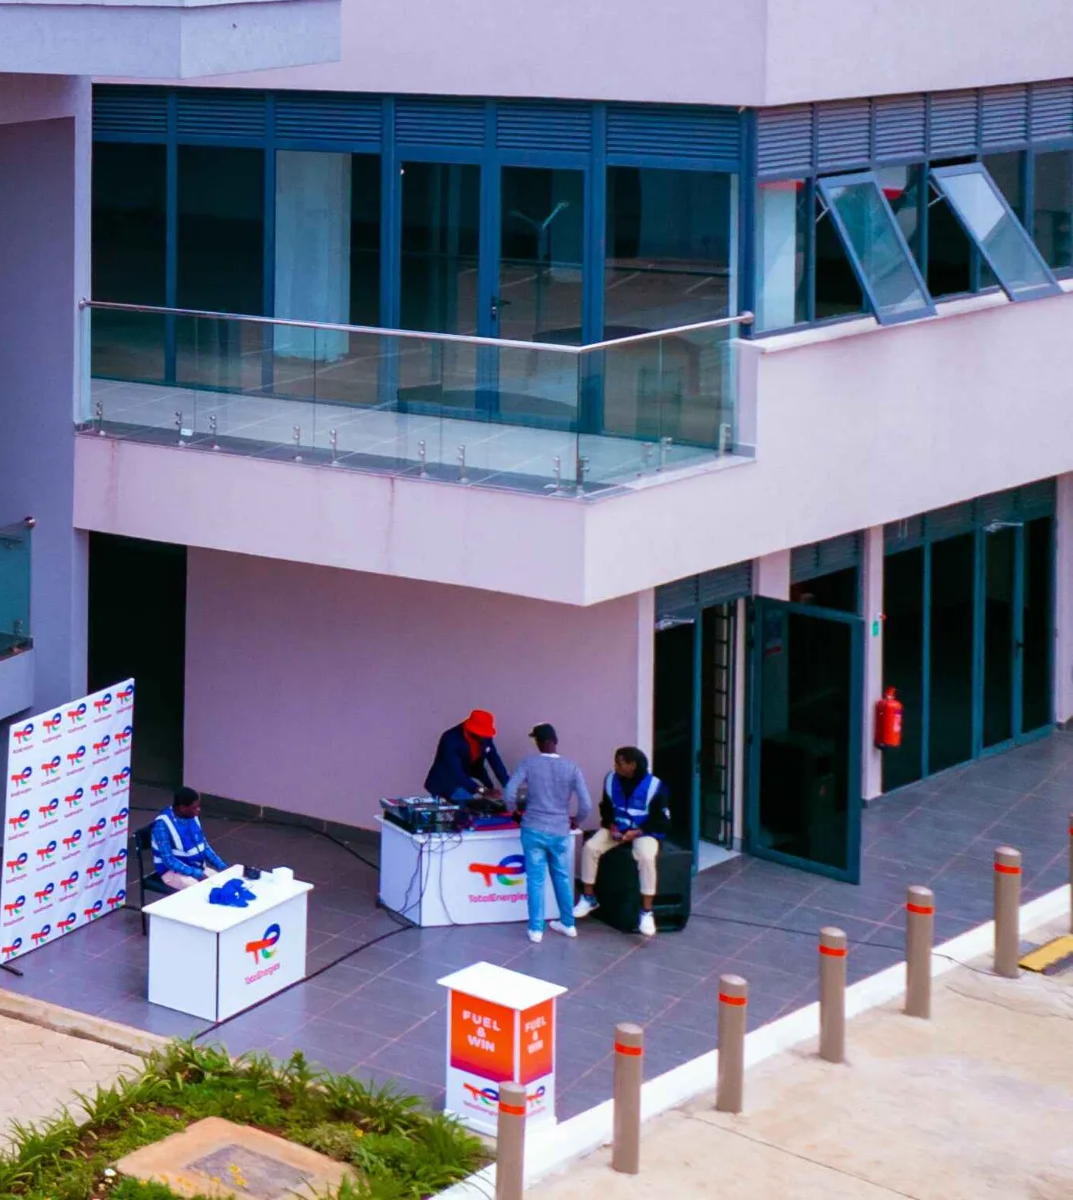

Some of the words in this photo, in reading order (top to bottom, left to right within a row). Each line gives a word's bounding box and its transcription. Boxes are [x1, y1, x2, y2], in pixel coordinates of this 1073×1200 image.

[462, 1010, 501, 1032] FUEL
[476, 1026, 486, 1038] &
[467, 1034, 495, 1053] WIN
